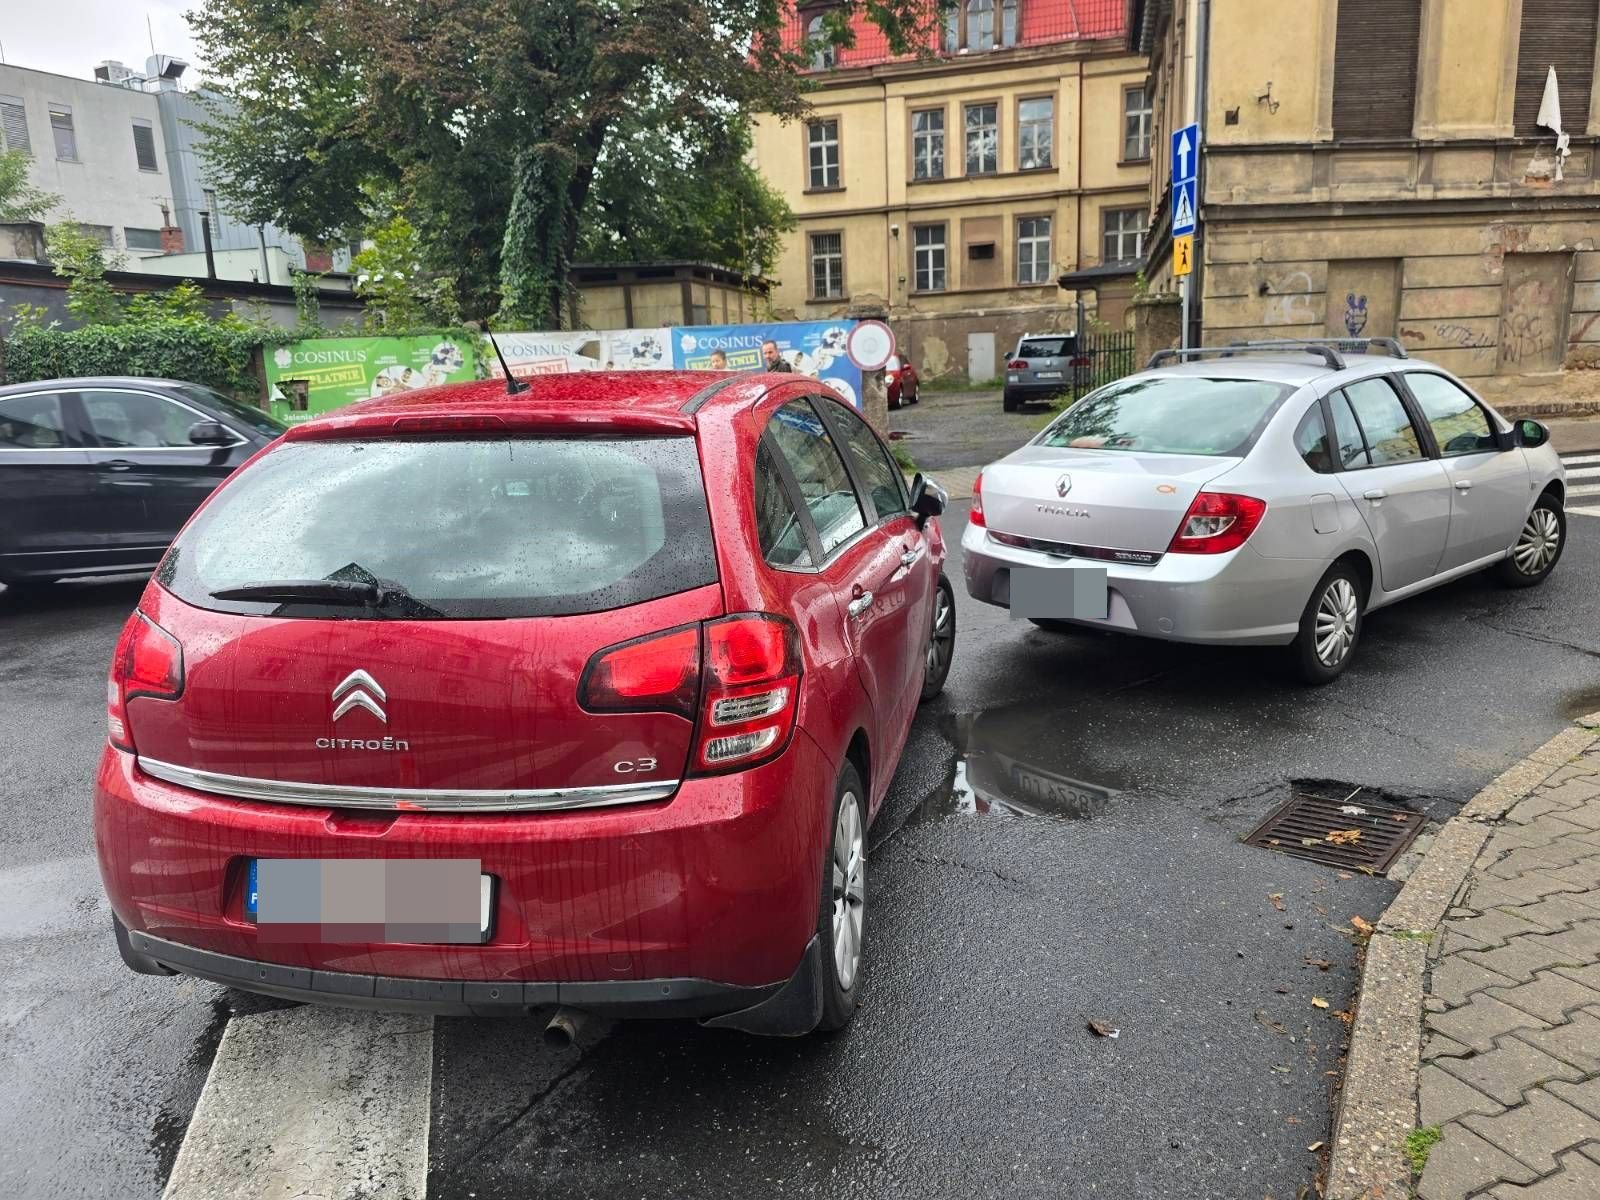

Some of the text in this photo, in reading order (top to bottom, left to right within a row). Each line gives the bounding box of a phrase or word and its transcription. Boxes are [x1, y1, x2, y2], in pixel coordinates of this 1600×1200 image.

[698, 335, 763, 349] COSINUS
[294, 350, 367, 364] COSINUS
[502, 344, 571, 357] COSINUS
[1034, 503, 1091, 519] THALIA
[314, 737, 409, 751] CITROËN
[613, 757, 658, 773] C3
